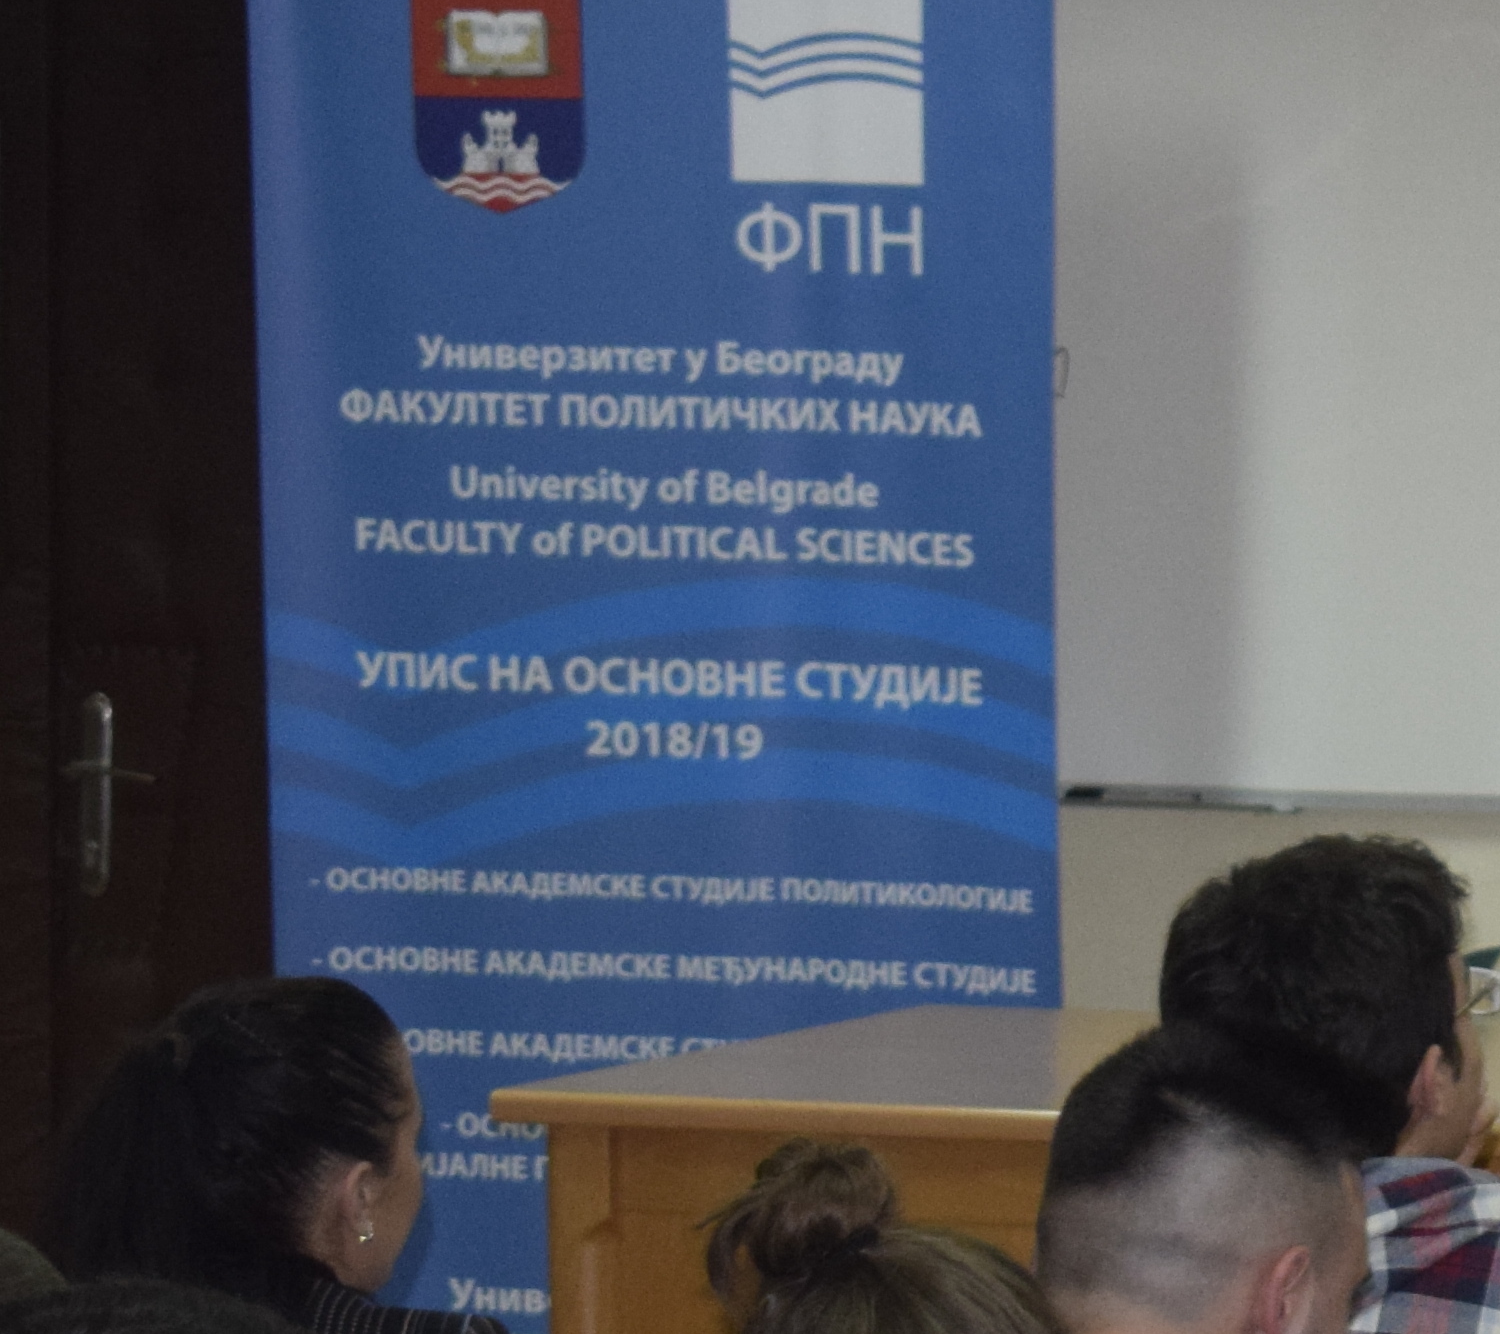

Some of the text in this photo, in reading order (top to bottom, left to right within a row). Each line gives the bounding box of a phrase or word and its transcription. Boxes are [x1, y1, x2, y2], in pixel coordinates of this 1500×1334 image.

[735, 201, 925, 276] ФПН
[416, 334, 904, 387] Универзитет у Београду
[339, 388, 983, 438] ФАКУЛТЕТ ПОЛИТИЧКИХ НАУКА
[450, 465, 880, 515] University of Belgrade
[355, 517, 976, 568] FACULTY of POLITICAL SCIENCES
[356, 651, 984, 710] УПИС НА ОСНОВНЕ СТУДИЈЕ
[586, 719, 765, 761] 2018/19
[325, 866, 466, 894] ОСНОВНЕ
[471, 870, 646, 900] АКАДЕМСКЕ
[651, 874, 775, 906] СТУДИЈЕ
[780, 876, 1033, 915] ПОЛИТИКОЛОГИЈЕ
[328, 945, 478, 975] ОСНОВНЕ
[484, 950, 670, 982] АКАДЕМСКЕ
[676, 955, 907, 991] МЕЂУНАРОДНЕ
[912, 961, 1037, 996] СТУДИЈЕ
[402, 1028, 483, 1056] ОВНЕ
[488, 1032, 675, 1063] АКАДЕМСКЕ
[457, 1111, 547, 1140] ОСНО
[420, 1151, 528, 1180] ИЈАЛНЕ
